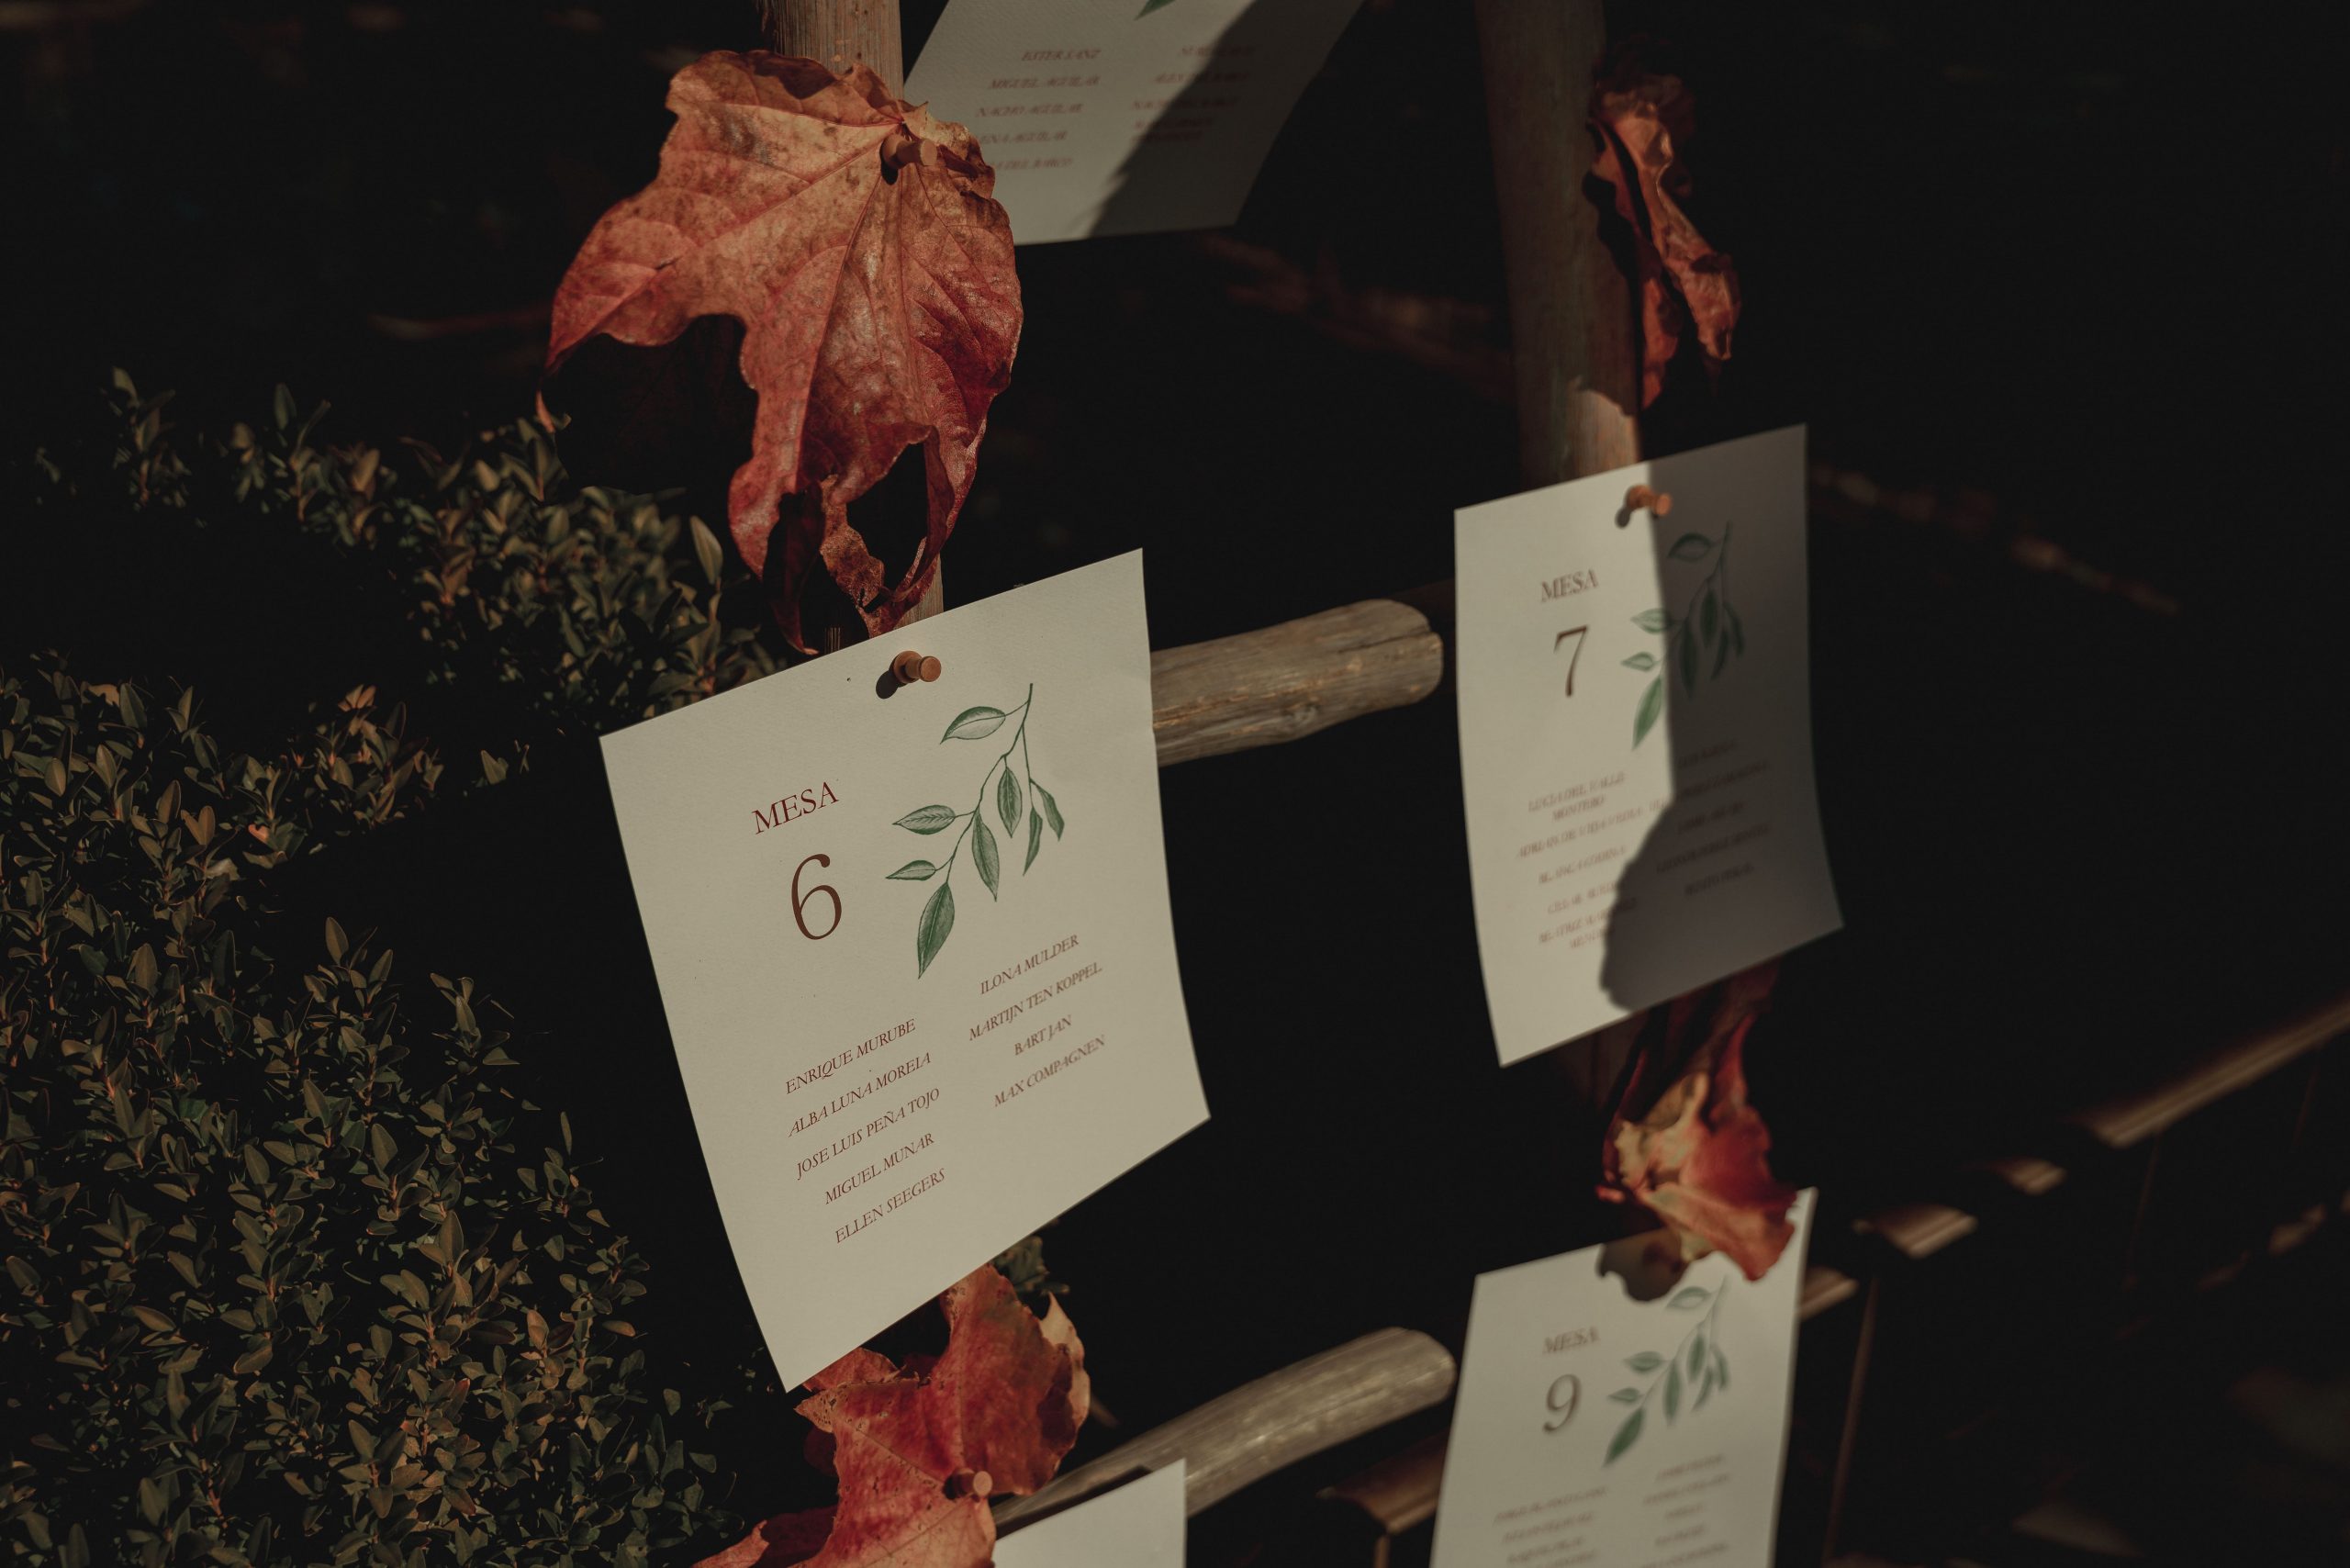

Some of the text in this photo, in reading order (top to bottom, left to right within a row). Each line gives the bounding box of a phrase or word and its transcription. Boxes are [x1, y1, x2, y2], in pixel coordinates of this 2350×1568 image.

[1541, 569, 1599, 603] MESA
[1553, 623, 1589, 699] 7
[752, 781, 839, 834] MESA
[791, 854, 842, 940] 6
[979, 935, 1080, 995] ILONA MULDER
[969, 962, 1103, 1042] MARTIJN TEN KOPPEL
[1014, 1014, 1072, 1056] BART JAN
[786, 1018, 916, 1094] ENRIQUE MURUBE
[993, 1035, 1106, 1107] MAX COMPAGNEN
[788, 1105, 829, 1137] ALBA
[831, 1082, 873, 1114] LUNA
[797, 1088, 940, 1181] JOSE LUIS PEÑA TOJO
[825, 1133, 934, 1204] MIGUEL MUNAR
[835, 1168, 946, 1243] ELLEN SEEGERS
[1542, 1326, 1601, 1354] MESA
[1543, 1373, 1581, 1433] 9
